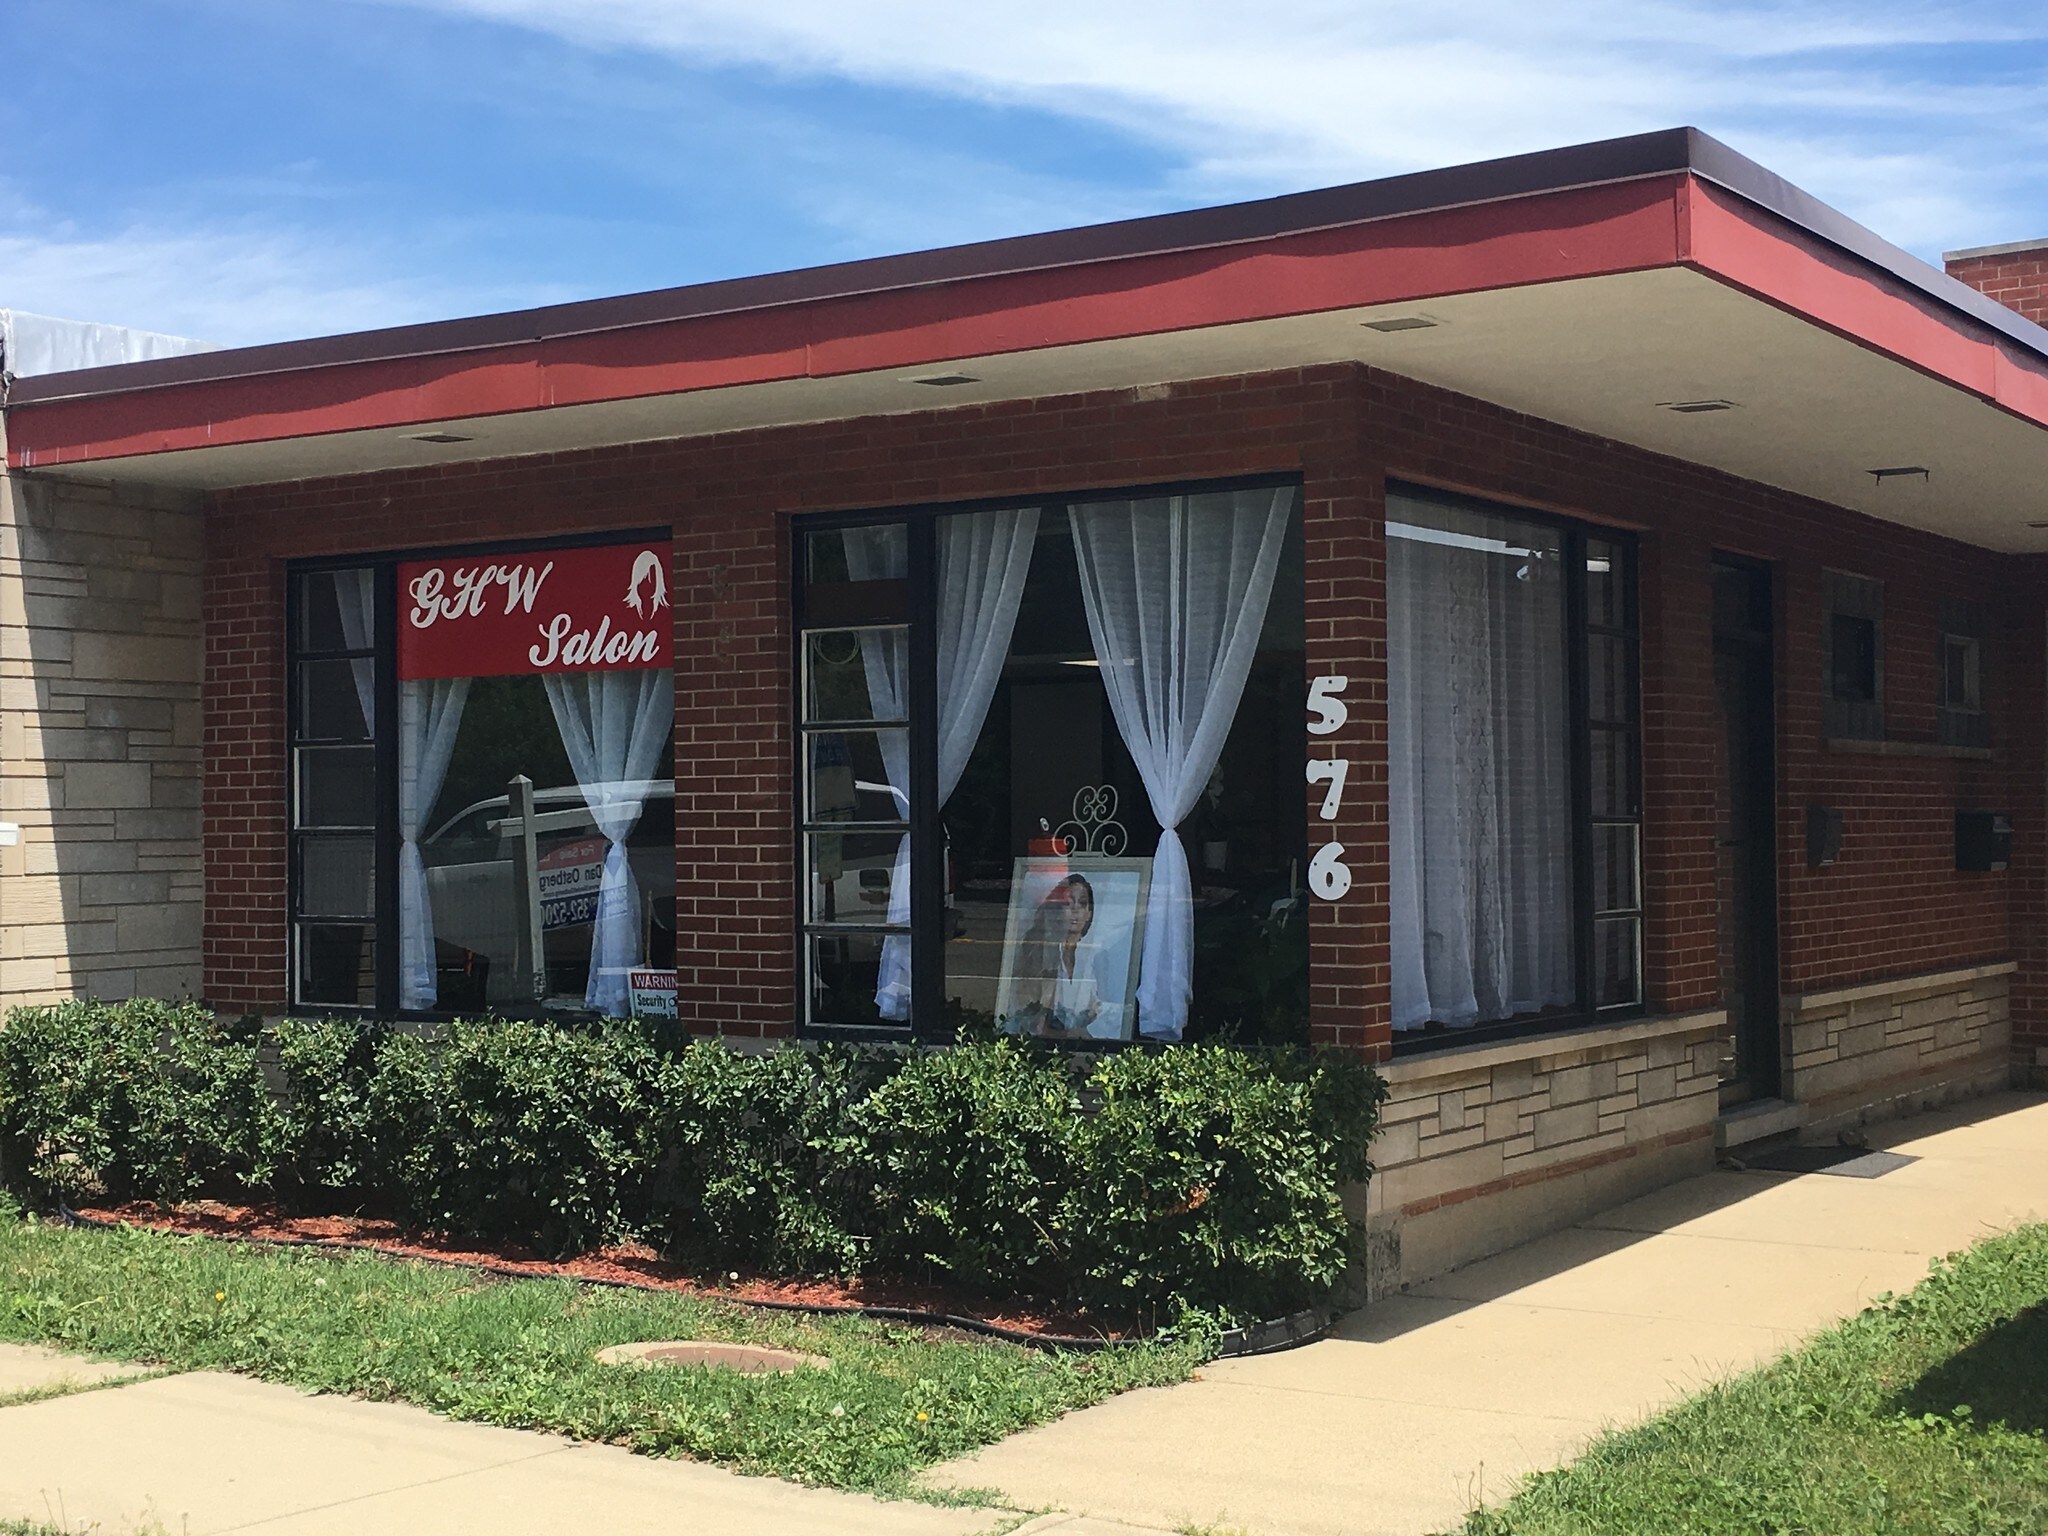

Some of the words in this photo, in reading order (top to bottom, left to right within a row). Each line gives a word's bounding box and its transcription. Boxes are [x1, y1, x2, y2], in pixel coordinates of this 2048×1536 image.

[409, 561, 553, 629] GHW
[528, 613, 660, 667] Salon
[637, 993, 667, 1010] Security
